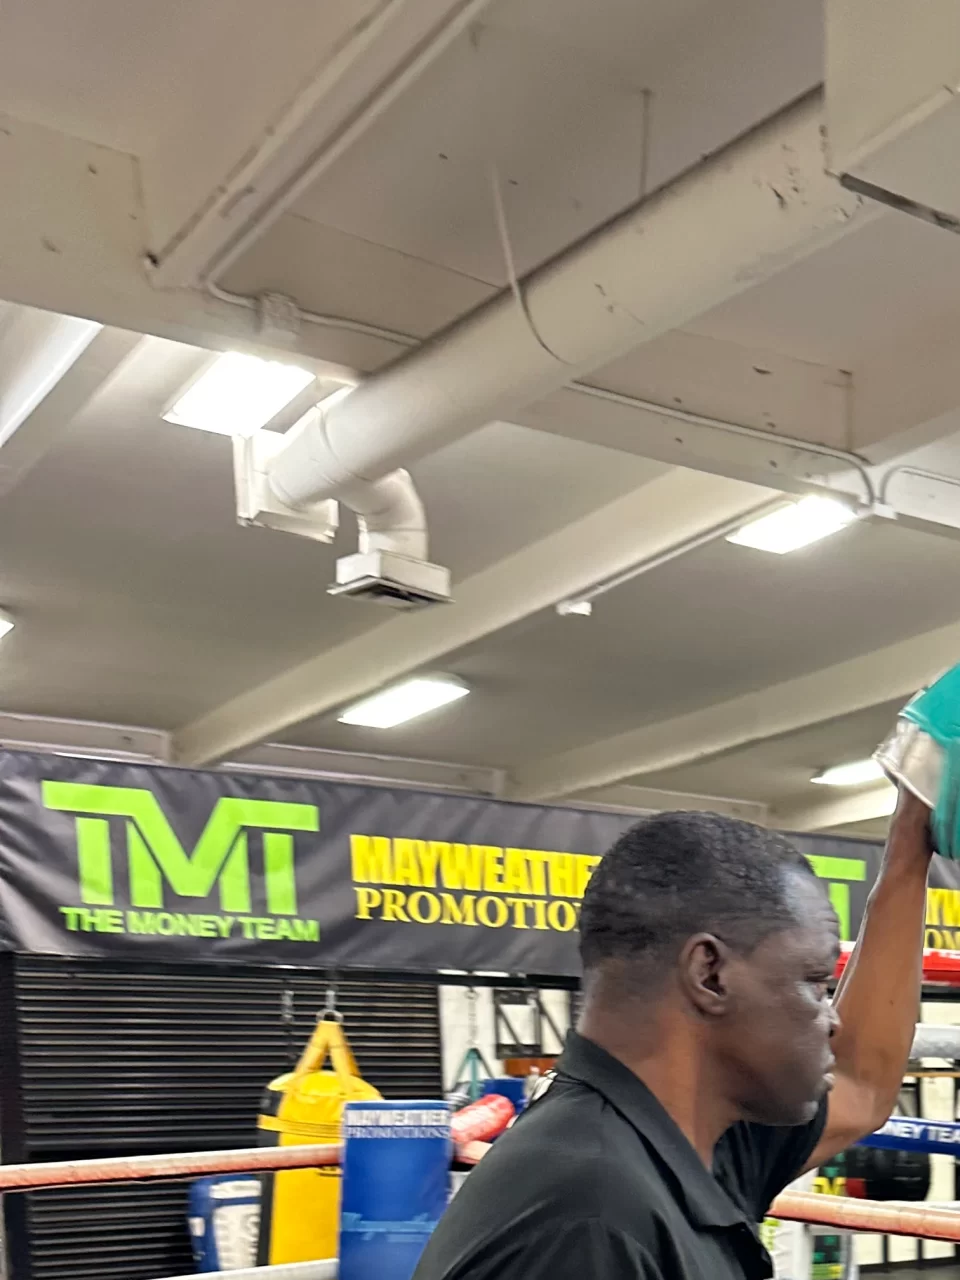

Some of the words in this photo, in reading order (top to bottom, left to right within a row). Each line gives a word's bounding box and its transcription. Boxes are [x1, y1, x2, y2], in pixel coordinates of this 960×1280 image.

[42, 780, 319, 916] TMT
[60, 907, 125, 933] THE
[126, 911, 233, 938] MONEY
[238, 917, 320, 942] TEAM
[353, 886, 583, 932] PROMOTIO
